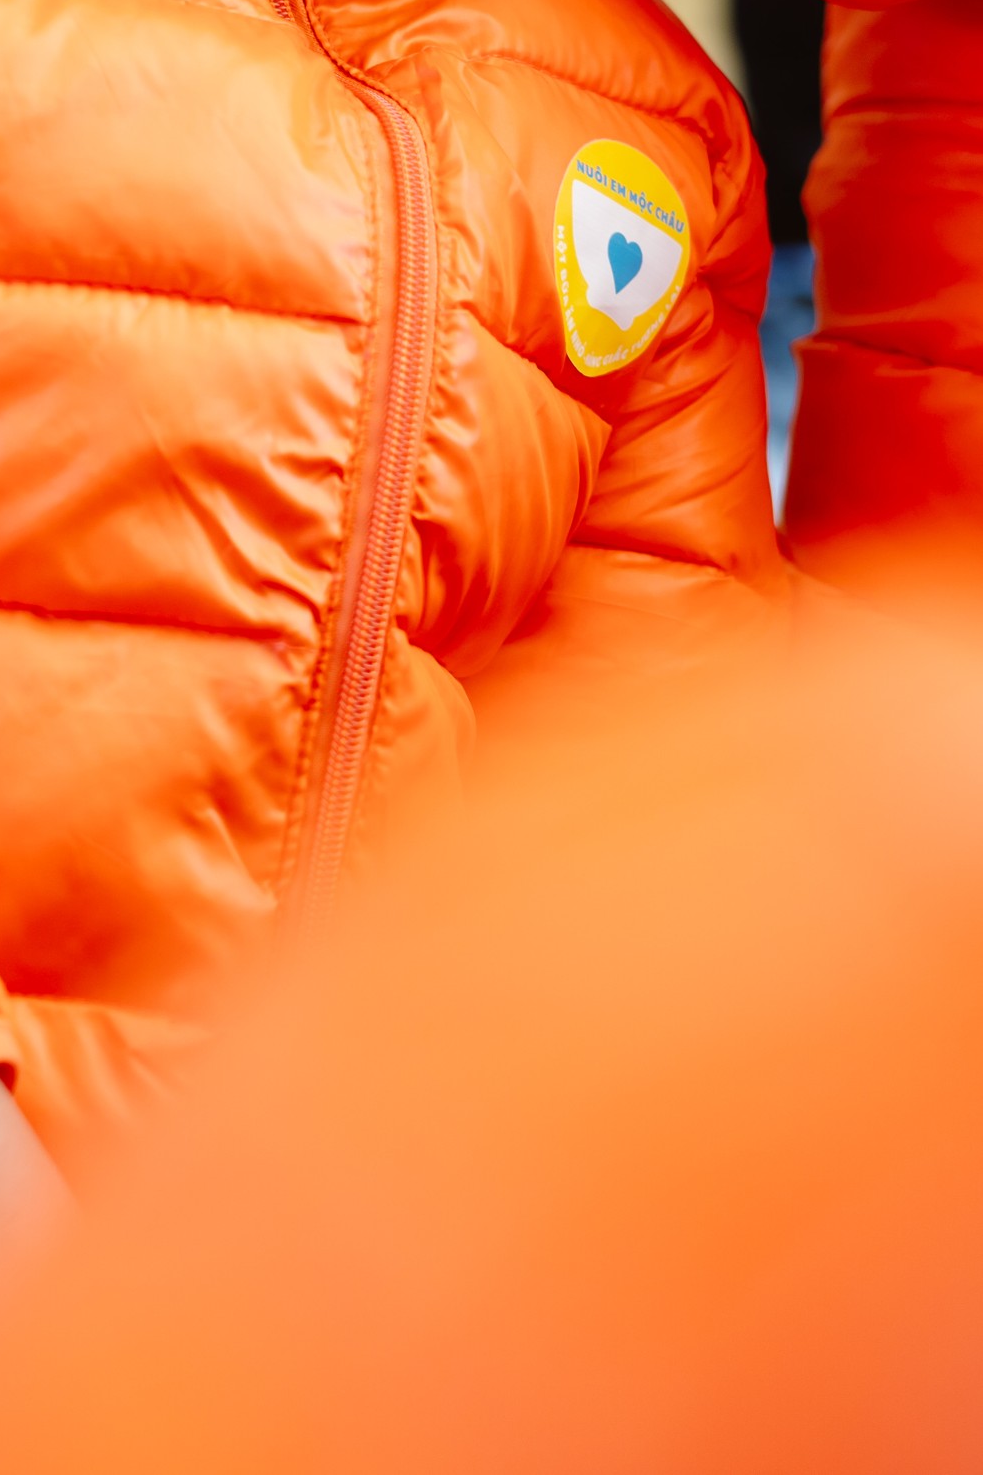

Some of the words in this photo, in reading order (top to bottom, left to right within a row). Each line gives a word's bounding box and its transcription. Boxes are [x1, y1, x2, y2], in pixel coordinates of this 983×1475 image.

[577, 160, 607, 186] NUÔI
[611, 179, 627, 198] EM
[629, 191, 653, 214] MỘC
[656, 207, 685, 233] CHÂU
